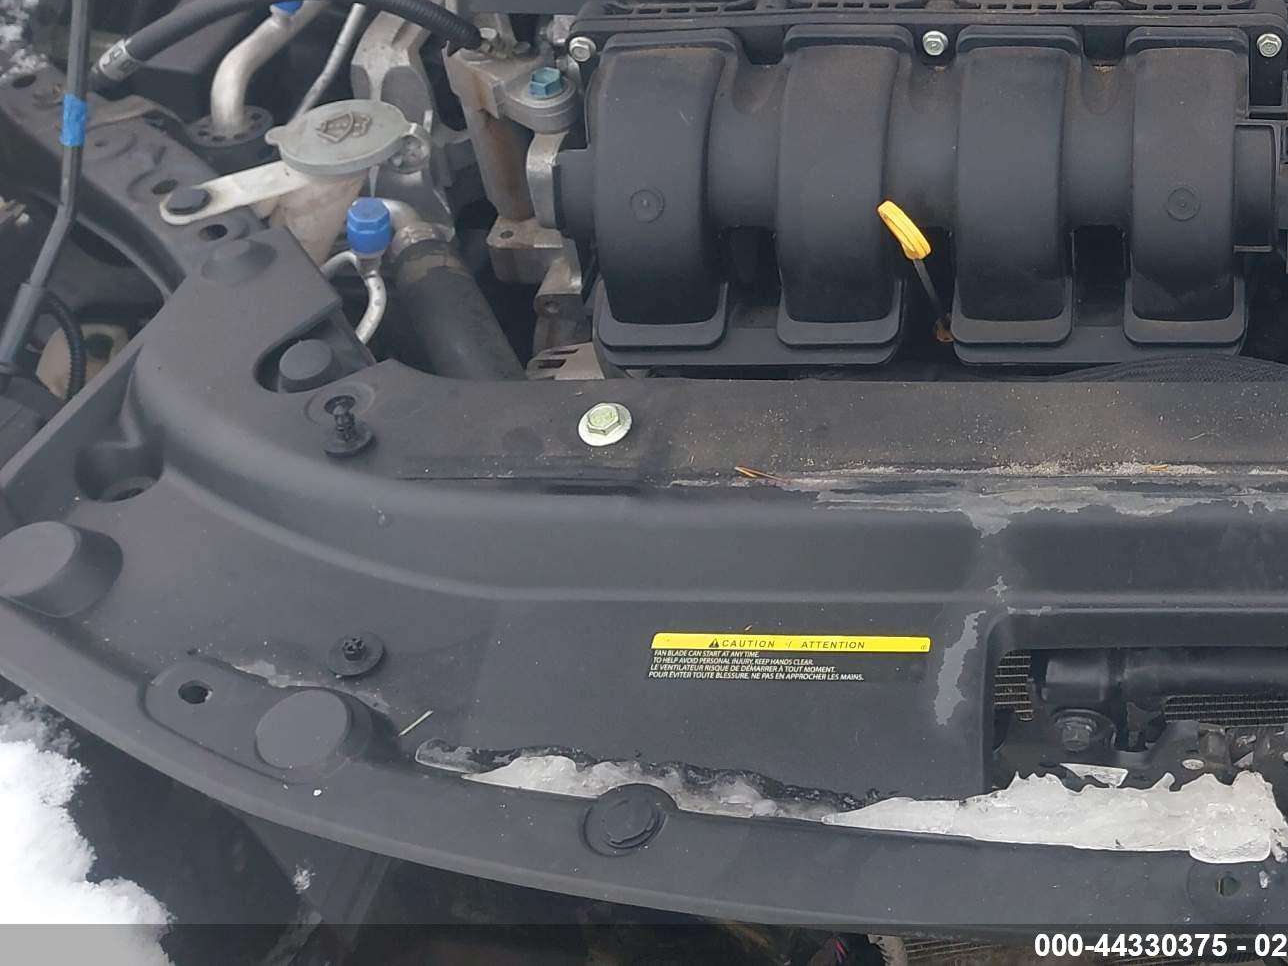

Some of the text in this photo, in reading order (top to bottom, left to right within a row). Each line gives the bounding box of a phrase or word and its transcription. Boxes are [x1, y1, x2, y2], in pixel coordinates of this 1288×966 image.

[721, 639, 776, 649] CAUTION
[801, 640, 866, 650] ATTENTION
[702, 650, 721, 658] START
[722, 650, 730, 658] AT
[730, 650, 744, 658] ANY
[662, 657, 680, 665] HELP
[679, 657, 699, 665] AVOID
[700, 657, 731, 665] PERSONAL
[755, 658, 771, 666] KEEP
[770, 658, 793, 666] HANDS
[659, 664, 704, 672] VENTILATEUR
[704, 664, 730, 672] RISQUE
[730, 664, 740, 672] DE
[785, 666, 804, 674] TOUT
[648, 671, 669, 679] POUR
[692, 671, 715, 679] TOUTE
[750, 672, 761, 681] NE
[761, 672, 775, 681] PAS
[775, 672, 786, 681] EN
[787, 672, 827, 681] APPROCHER
[826, 673, 839, 681] LES
